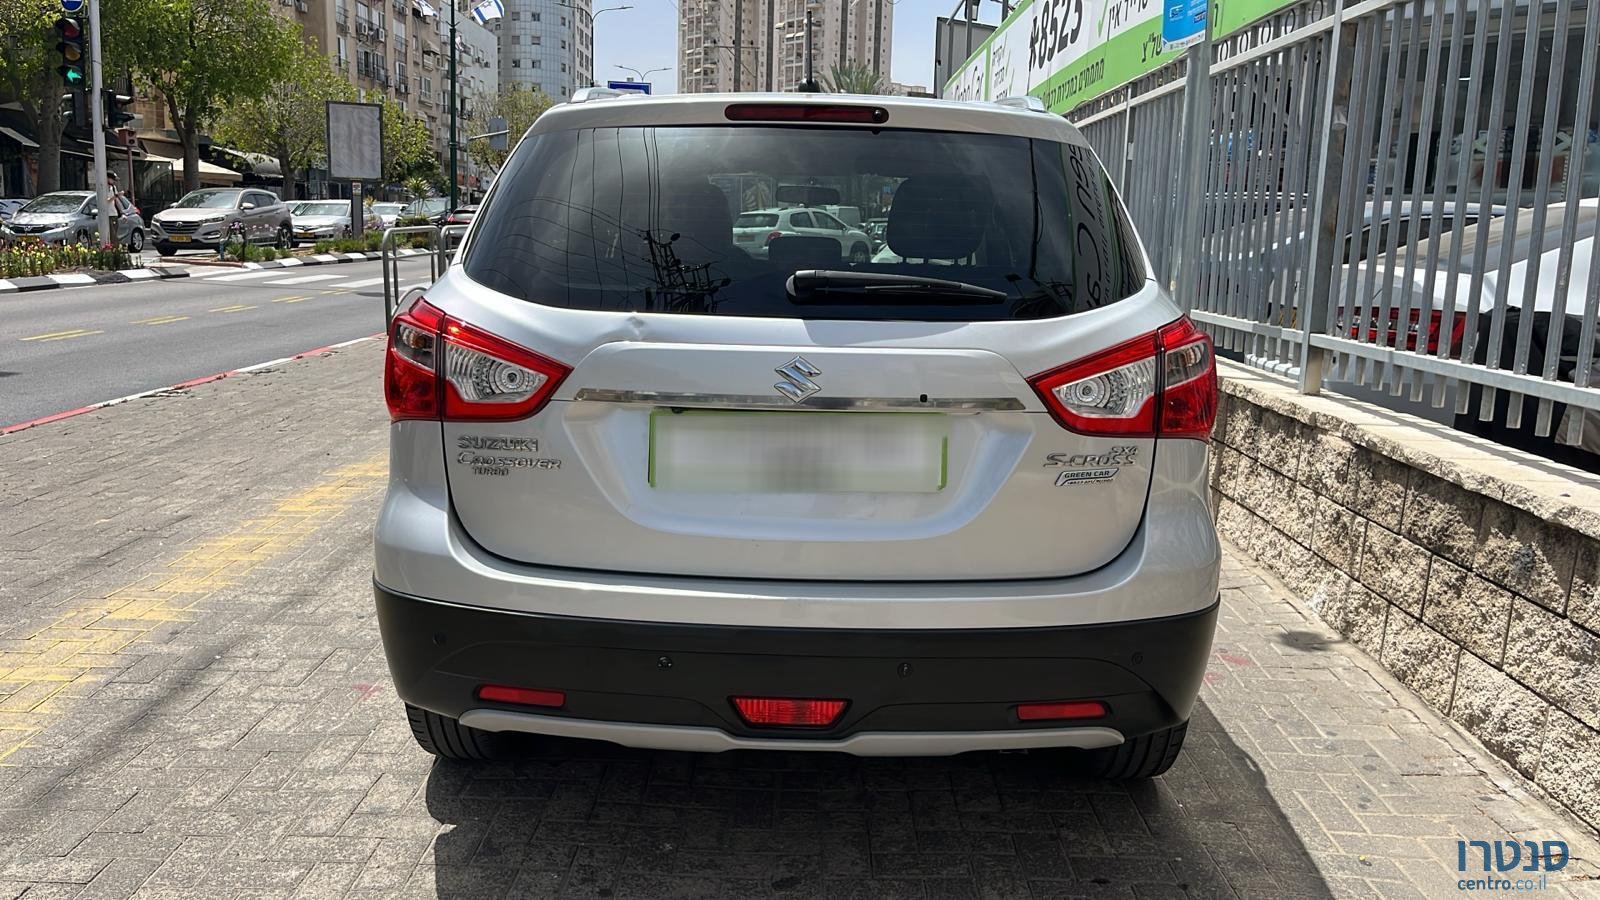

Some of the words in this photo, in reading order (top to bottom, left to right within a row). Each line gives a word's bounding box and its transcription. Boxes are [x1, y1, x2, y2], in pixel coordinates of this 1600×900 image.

[457, 435, 539, 452] SUZUKI
[472, 466, 509, 476] TURBO
[1064, 471, 1092, 479] GREEN
[1093, 470, 1110, 478] CAR
